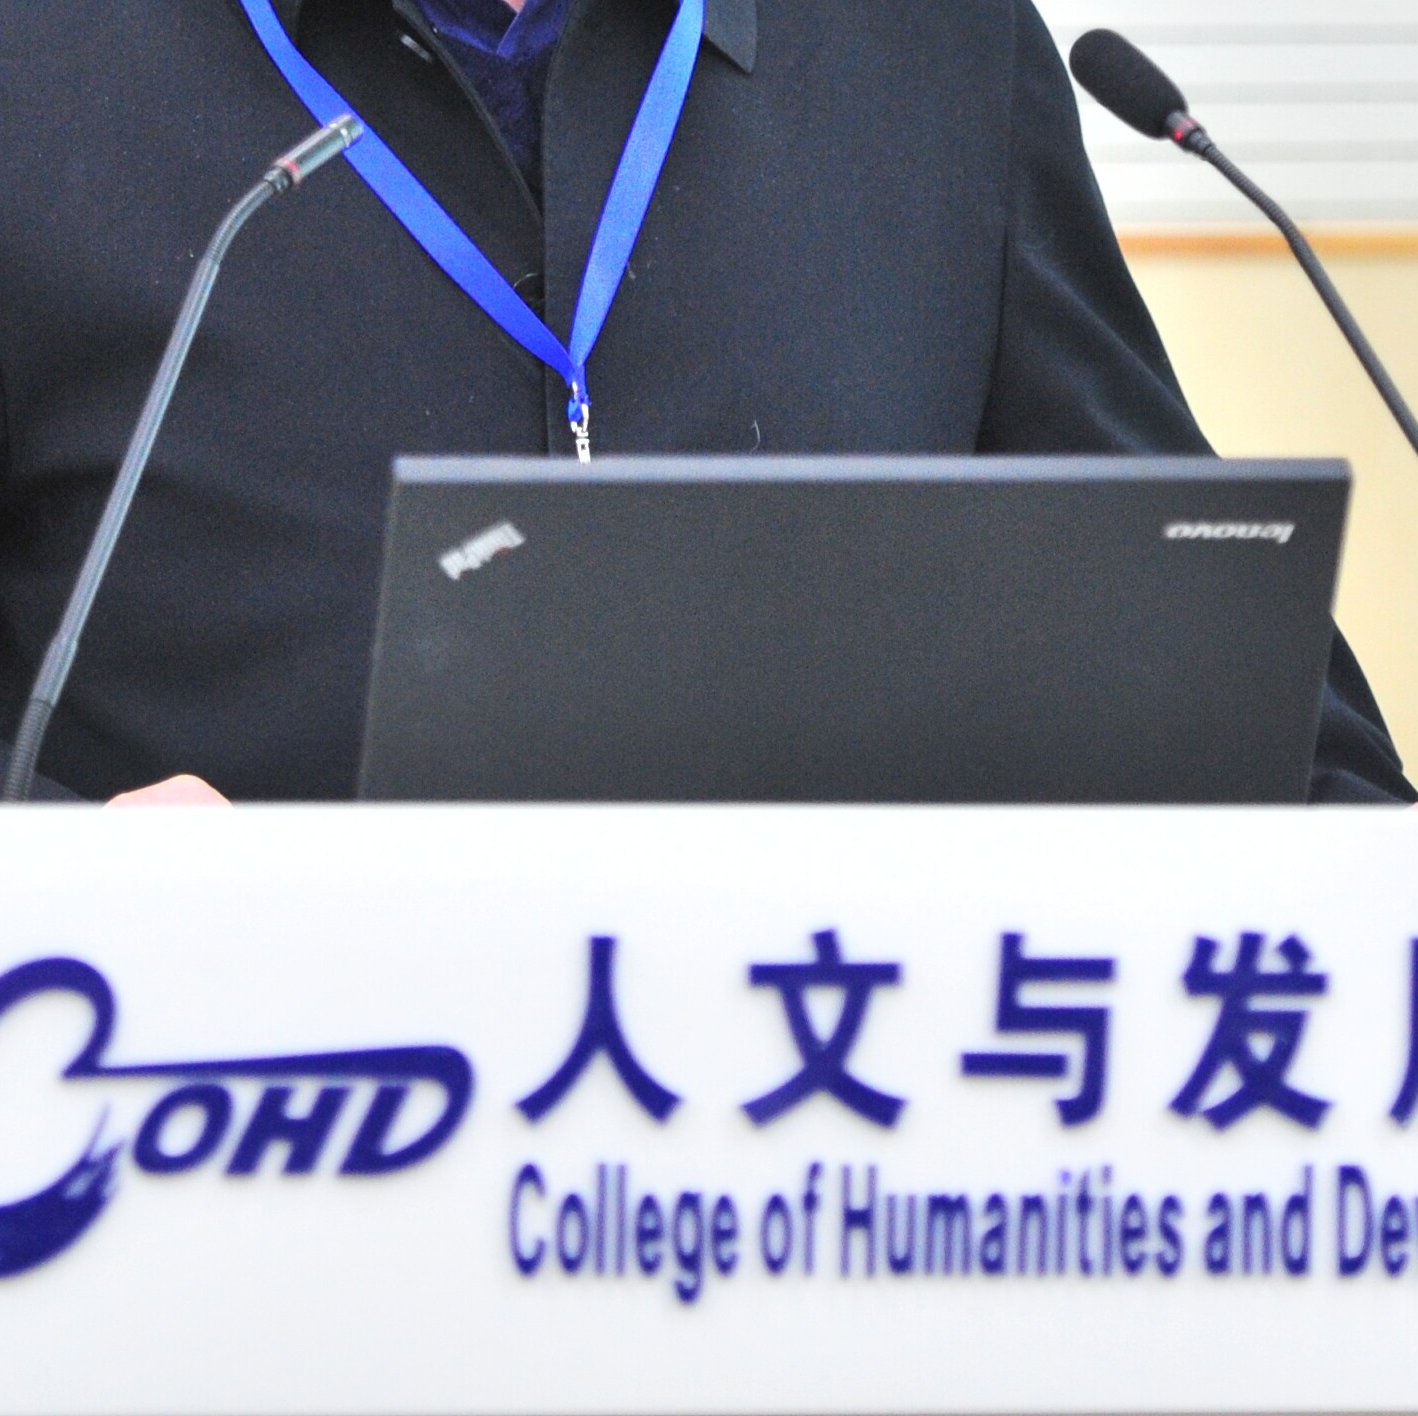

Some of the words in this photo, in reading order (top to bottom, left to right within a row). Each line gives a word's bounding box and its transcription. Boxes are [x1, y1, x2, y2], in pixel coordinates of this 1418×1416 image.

[508, 1161, 740, 1306] College
[758, 1160, 824, 1276] of
[838, 1164, 1184, 1278] Humanities
[1201, 1164, 1314, 1278] and
